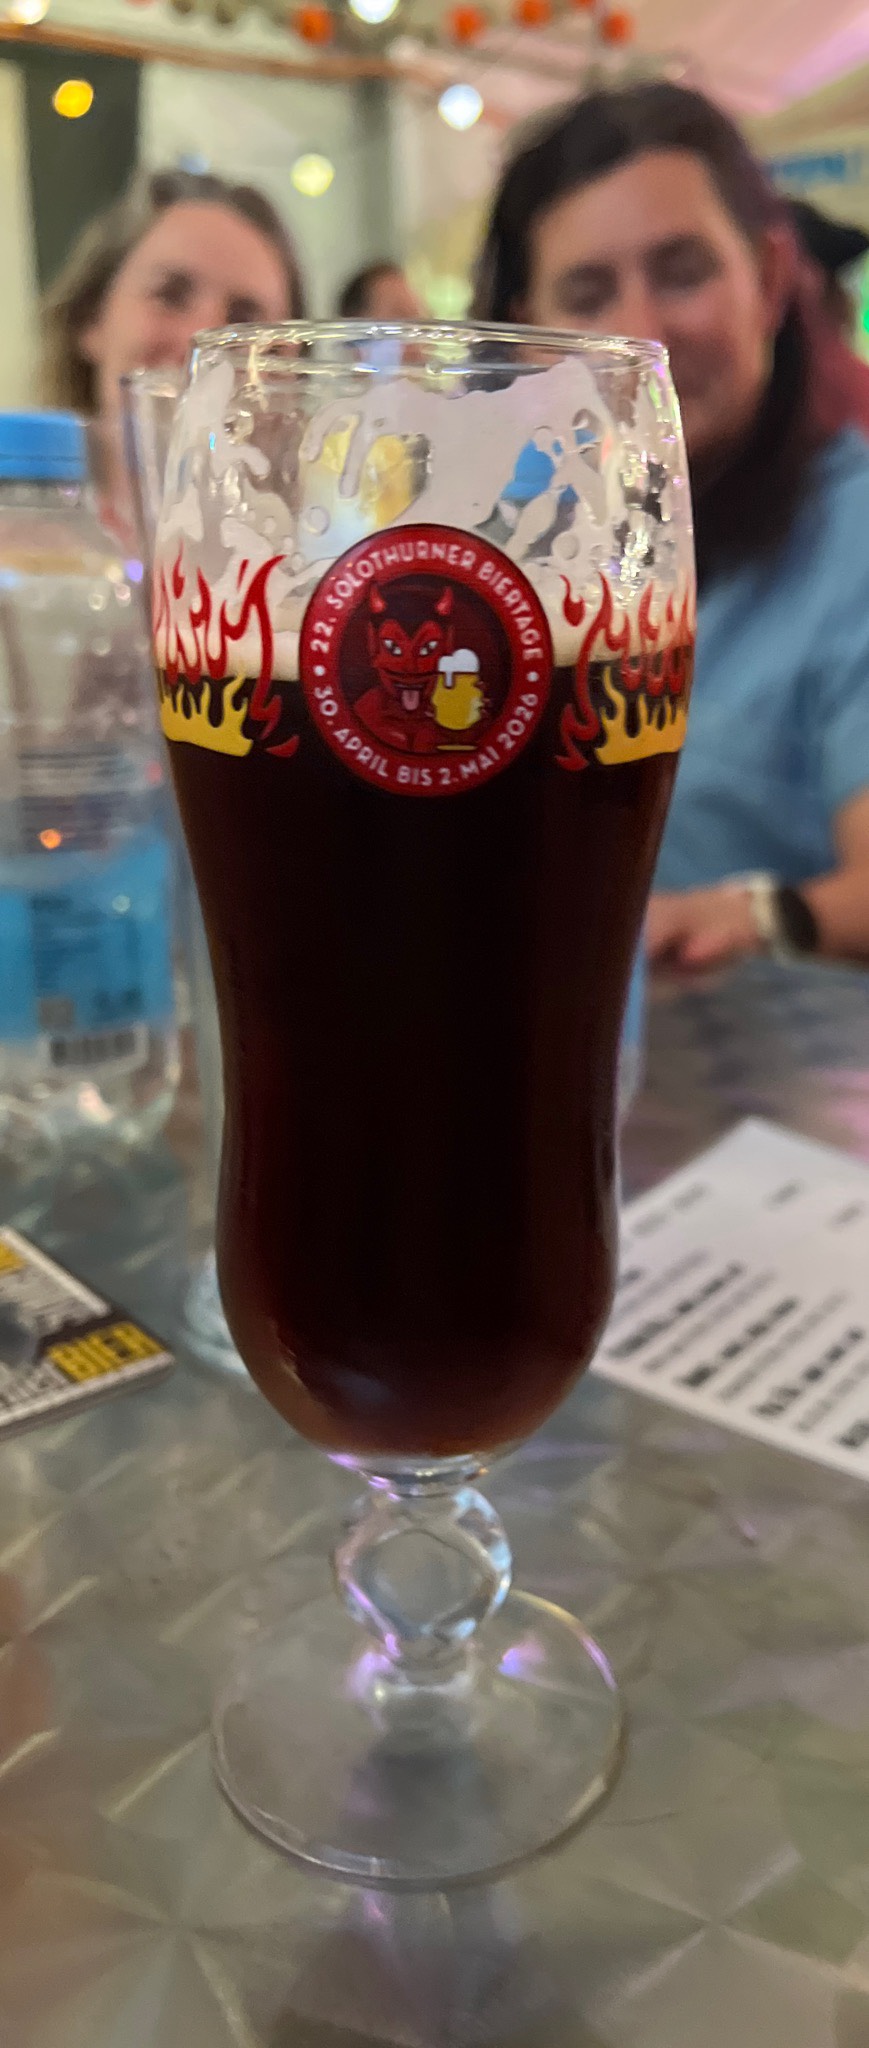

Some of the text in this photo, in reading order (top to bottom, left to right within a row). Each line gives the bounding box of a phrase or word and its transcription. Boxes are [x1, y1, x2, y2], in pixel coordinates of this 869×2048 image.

[310, 540, 544, 661] 22. SOLOTHURNER BIERTAGE
[314, 686, 539, 786] 30. APRIL BIS 2. MAI 2026
[50, 1322, 166, 1384] BIER
